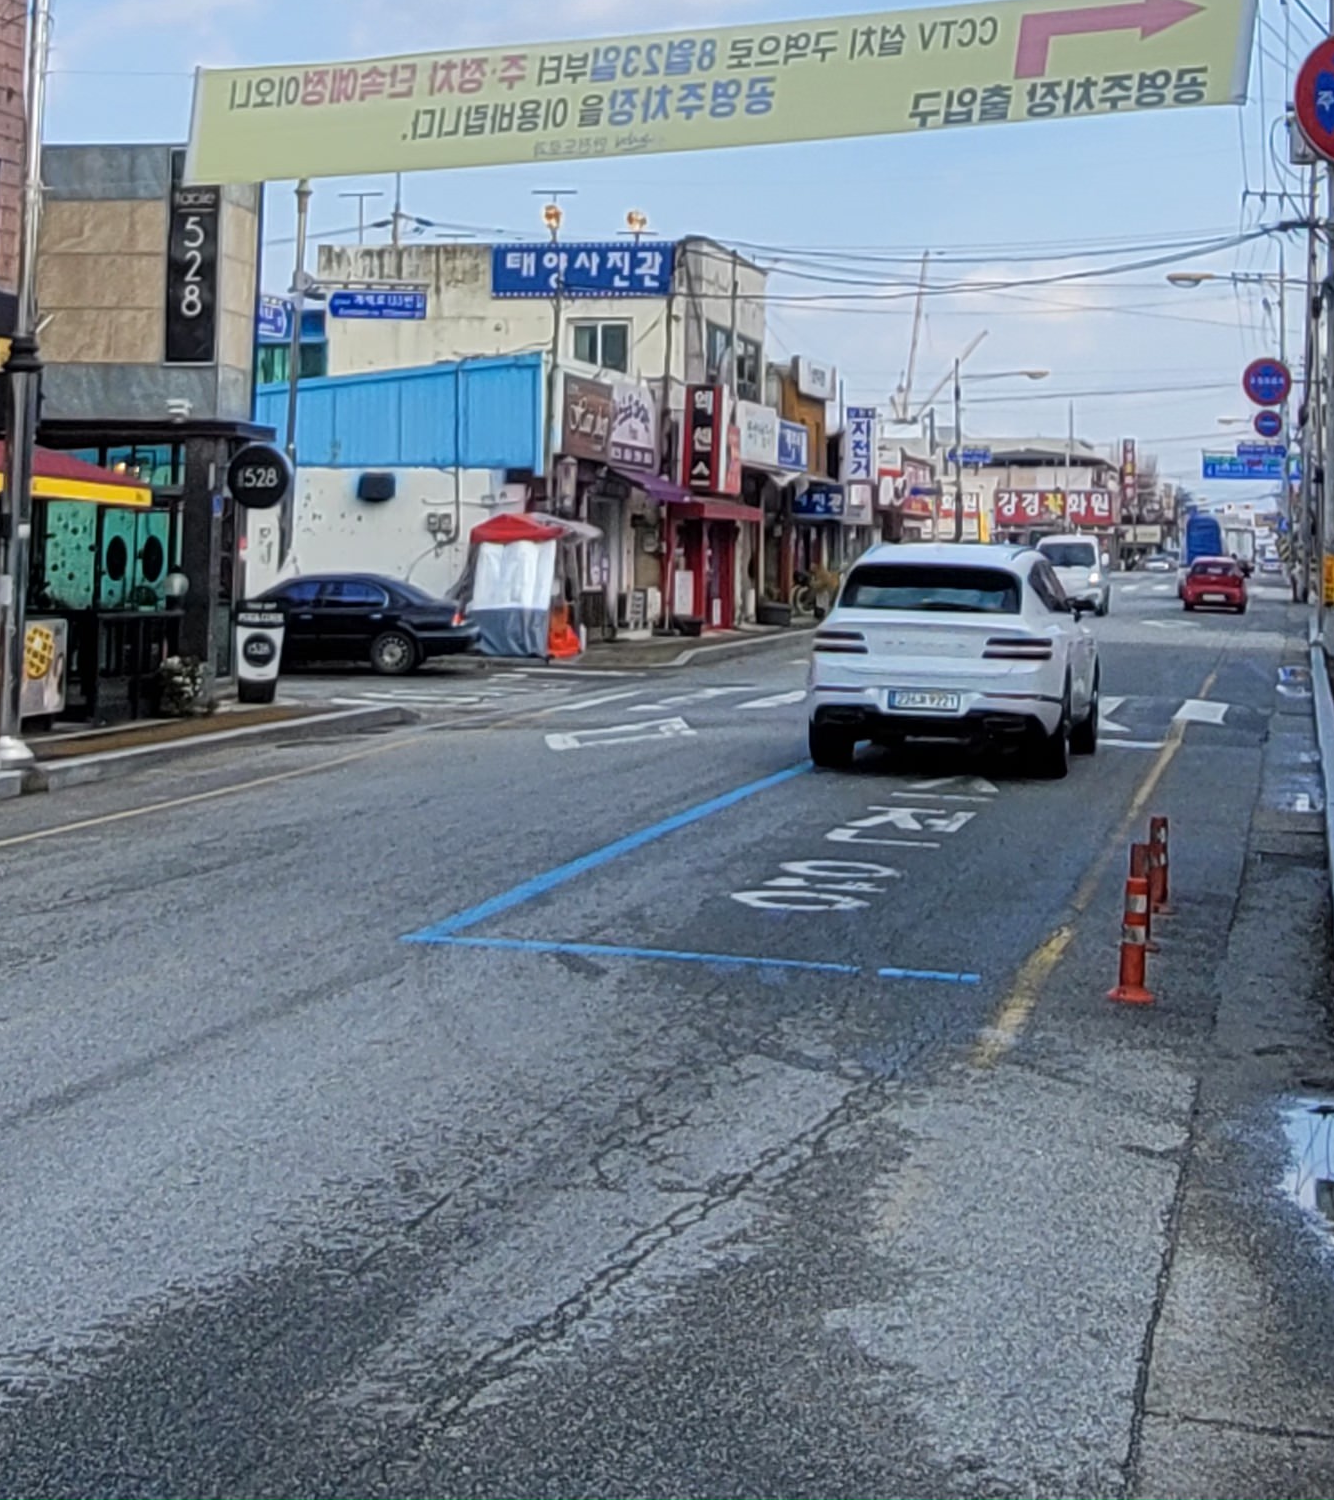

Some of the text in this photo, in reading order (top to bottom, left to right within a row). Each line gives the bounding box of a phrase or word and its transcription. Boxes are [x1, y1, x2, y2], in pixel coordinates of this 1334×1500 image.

[181, 216, 205, 317] 528
[505, 251, 663, 290] 태양사진관
[851, 418, 872, 479] 자전거
[243, 467, 279, 488] 528
